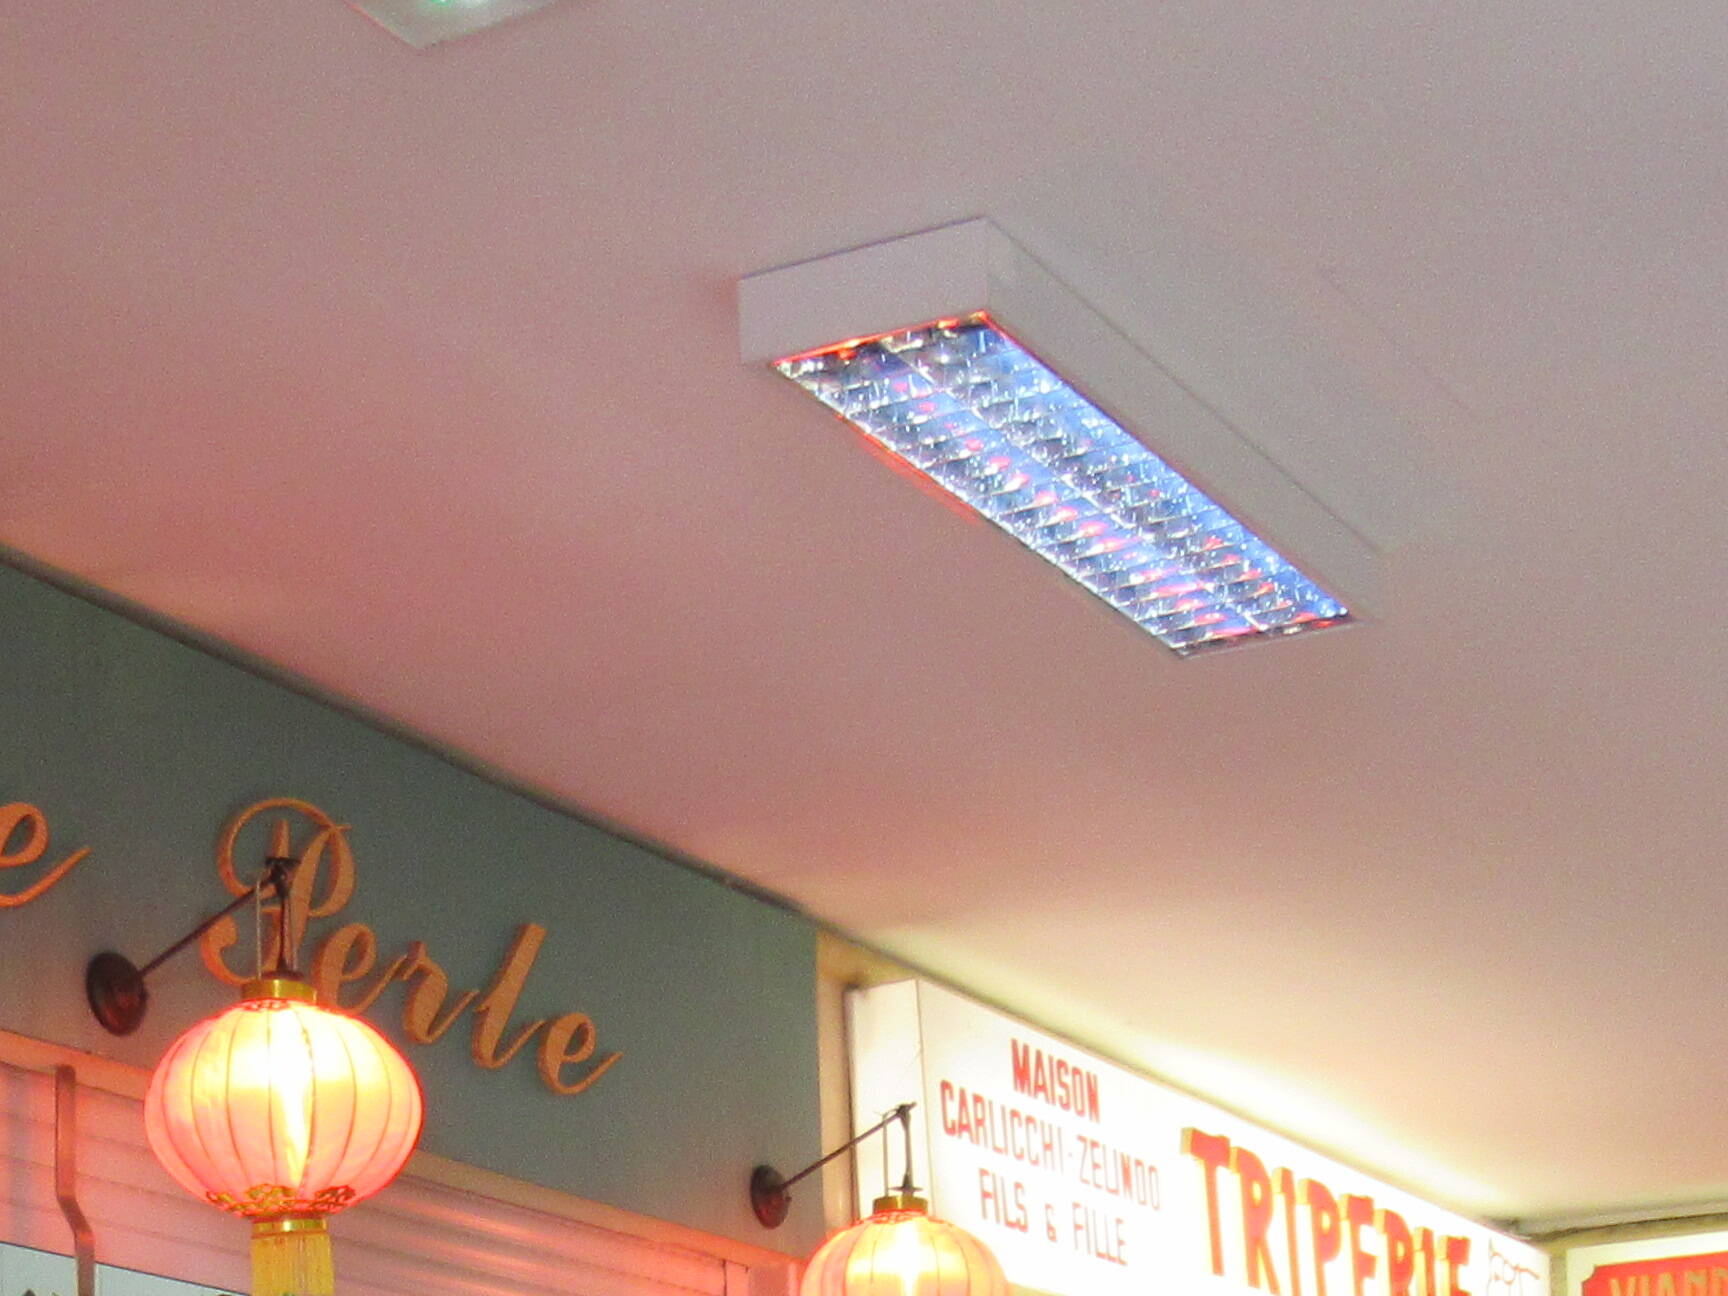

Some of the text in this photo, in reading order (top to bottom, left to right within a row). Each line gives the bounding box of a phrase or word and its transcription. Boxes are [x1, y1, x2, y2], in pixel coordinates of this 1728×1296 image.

[200, 797, 624, 1095] Perle
[1010, 1038, 1101, 1124] MAISON
[978, 1167, 1029, 1233] FILS
[1072, 1201, 1129, 1267] FILLE
